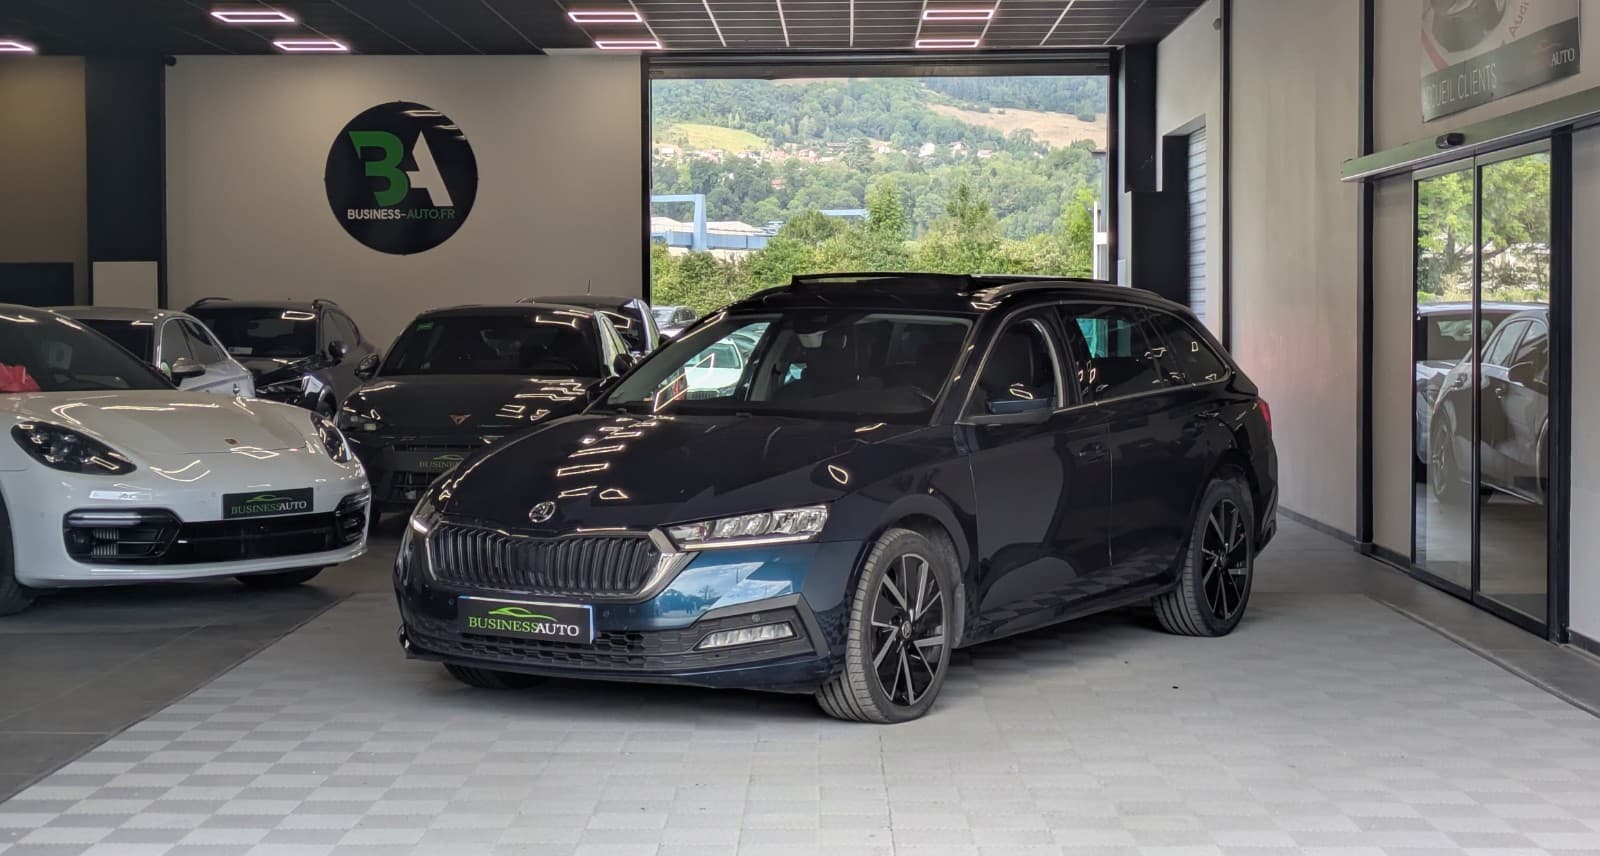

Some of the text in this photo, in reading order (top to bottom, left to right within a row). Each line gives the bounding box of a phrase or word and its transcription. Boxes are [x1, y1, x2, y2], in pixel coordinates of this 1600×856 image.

[1551, 47, 1575, 66] AUTO
[1457, 63, 1497, 99] CLIENTS
[347, 208, 455, 220] BUSINESS-AUTO.FR
